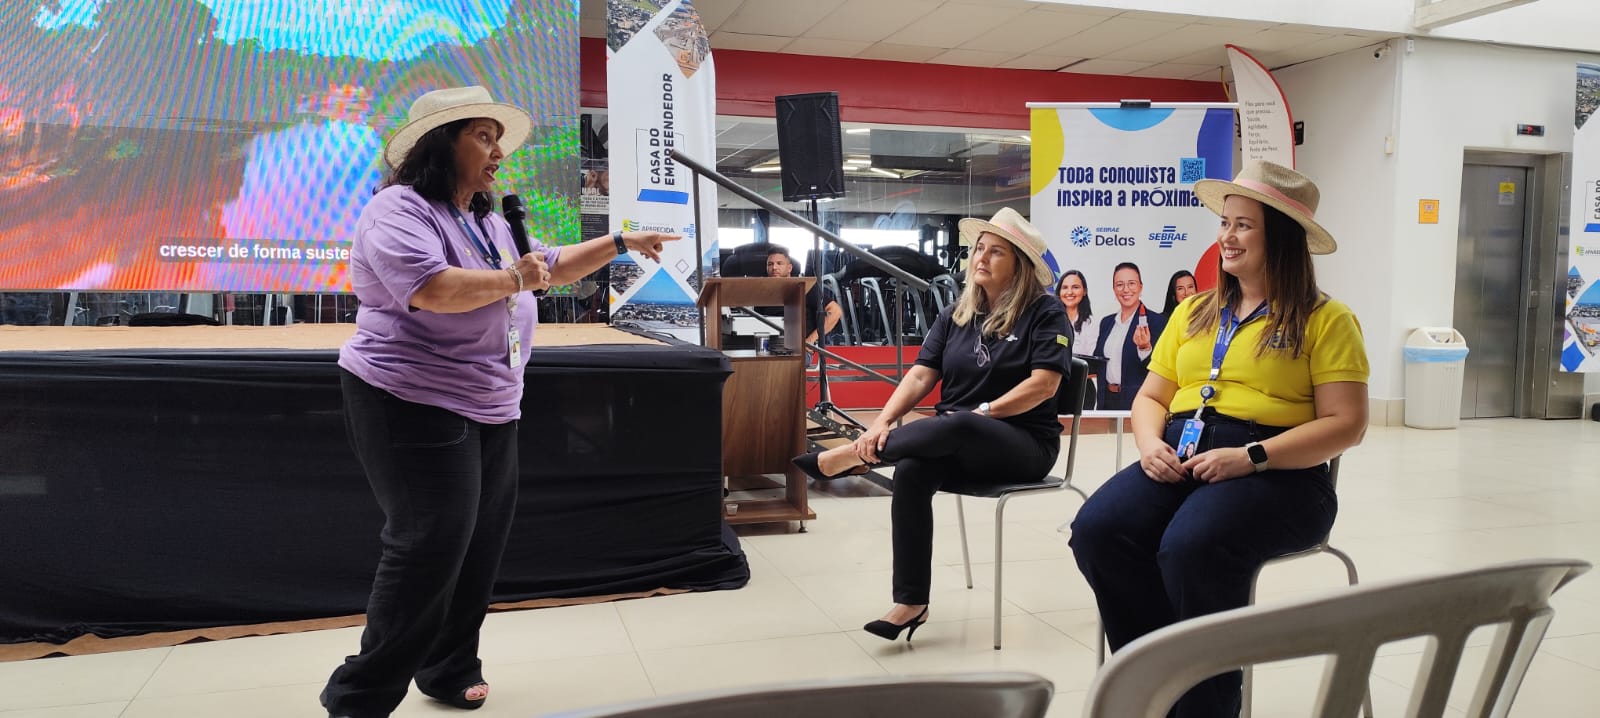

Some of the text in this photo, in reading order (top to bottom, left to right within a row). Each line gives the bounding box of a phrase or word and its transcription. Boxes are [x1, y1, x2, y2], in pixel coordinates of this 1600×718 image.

[663, 73, 675, 186] EMPREENDEDOR
[649, 128, 661, 184] CASA DO
[1095, 234, 1136, 247] Delas
[1148, 232, 1188, 241] SEBRAE
[160, 244, 224, 257] crescer
[228, 243, 249, 258] de
[253, 244, 301, 260] forma
